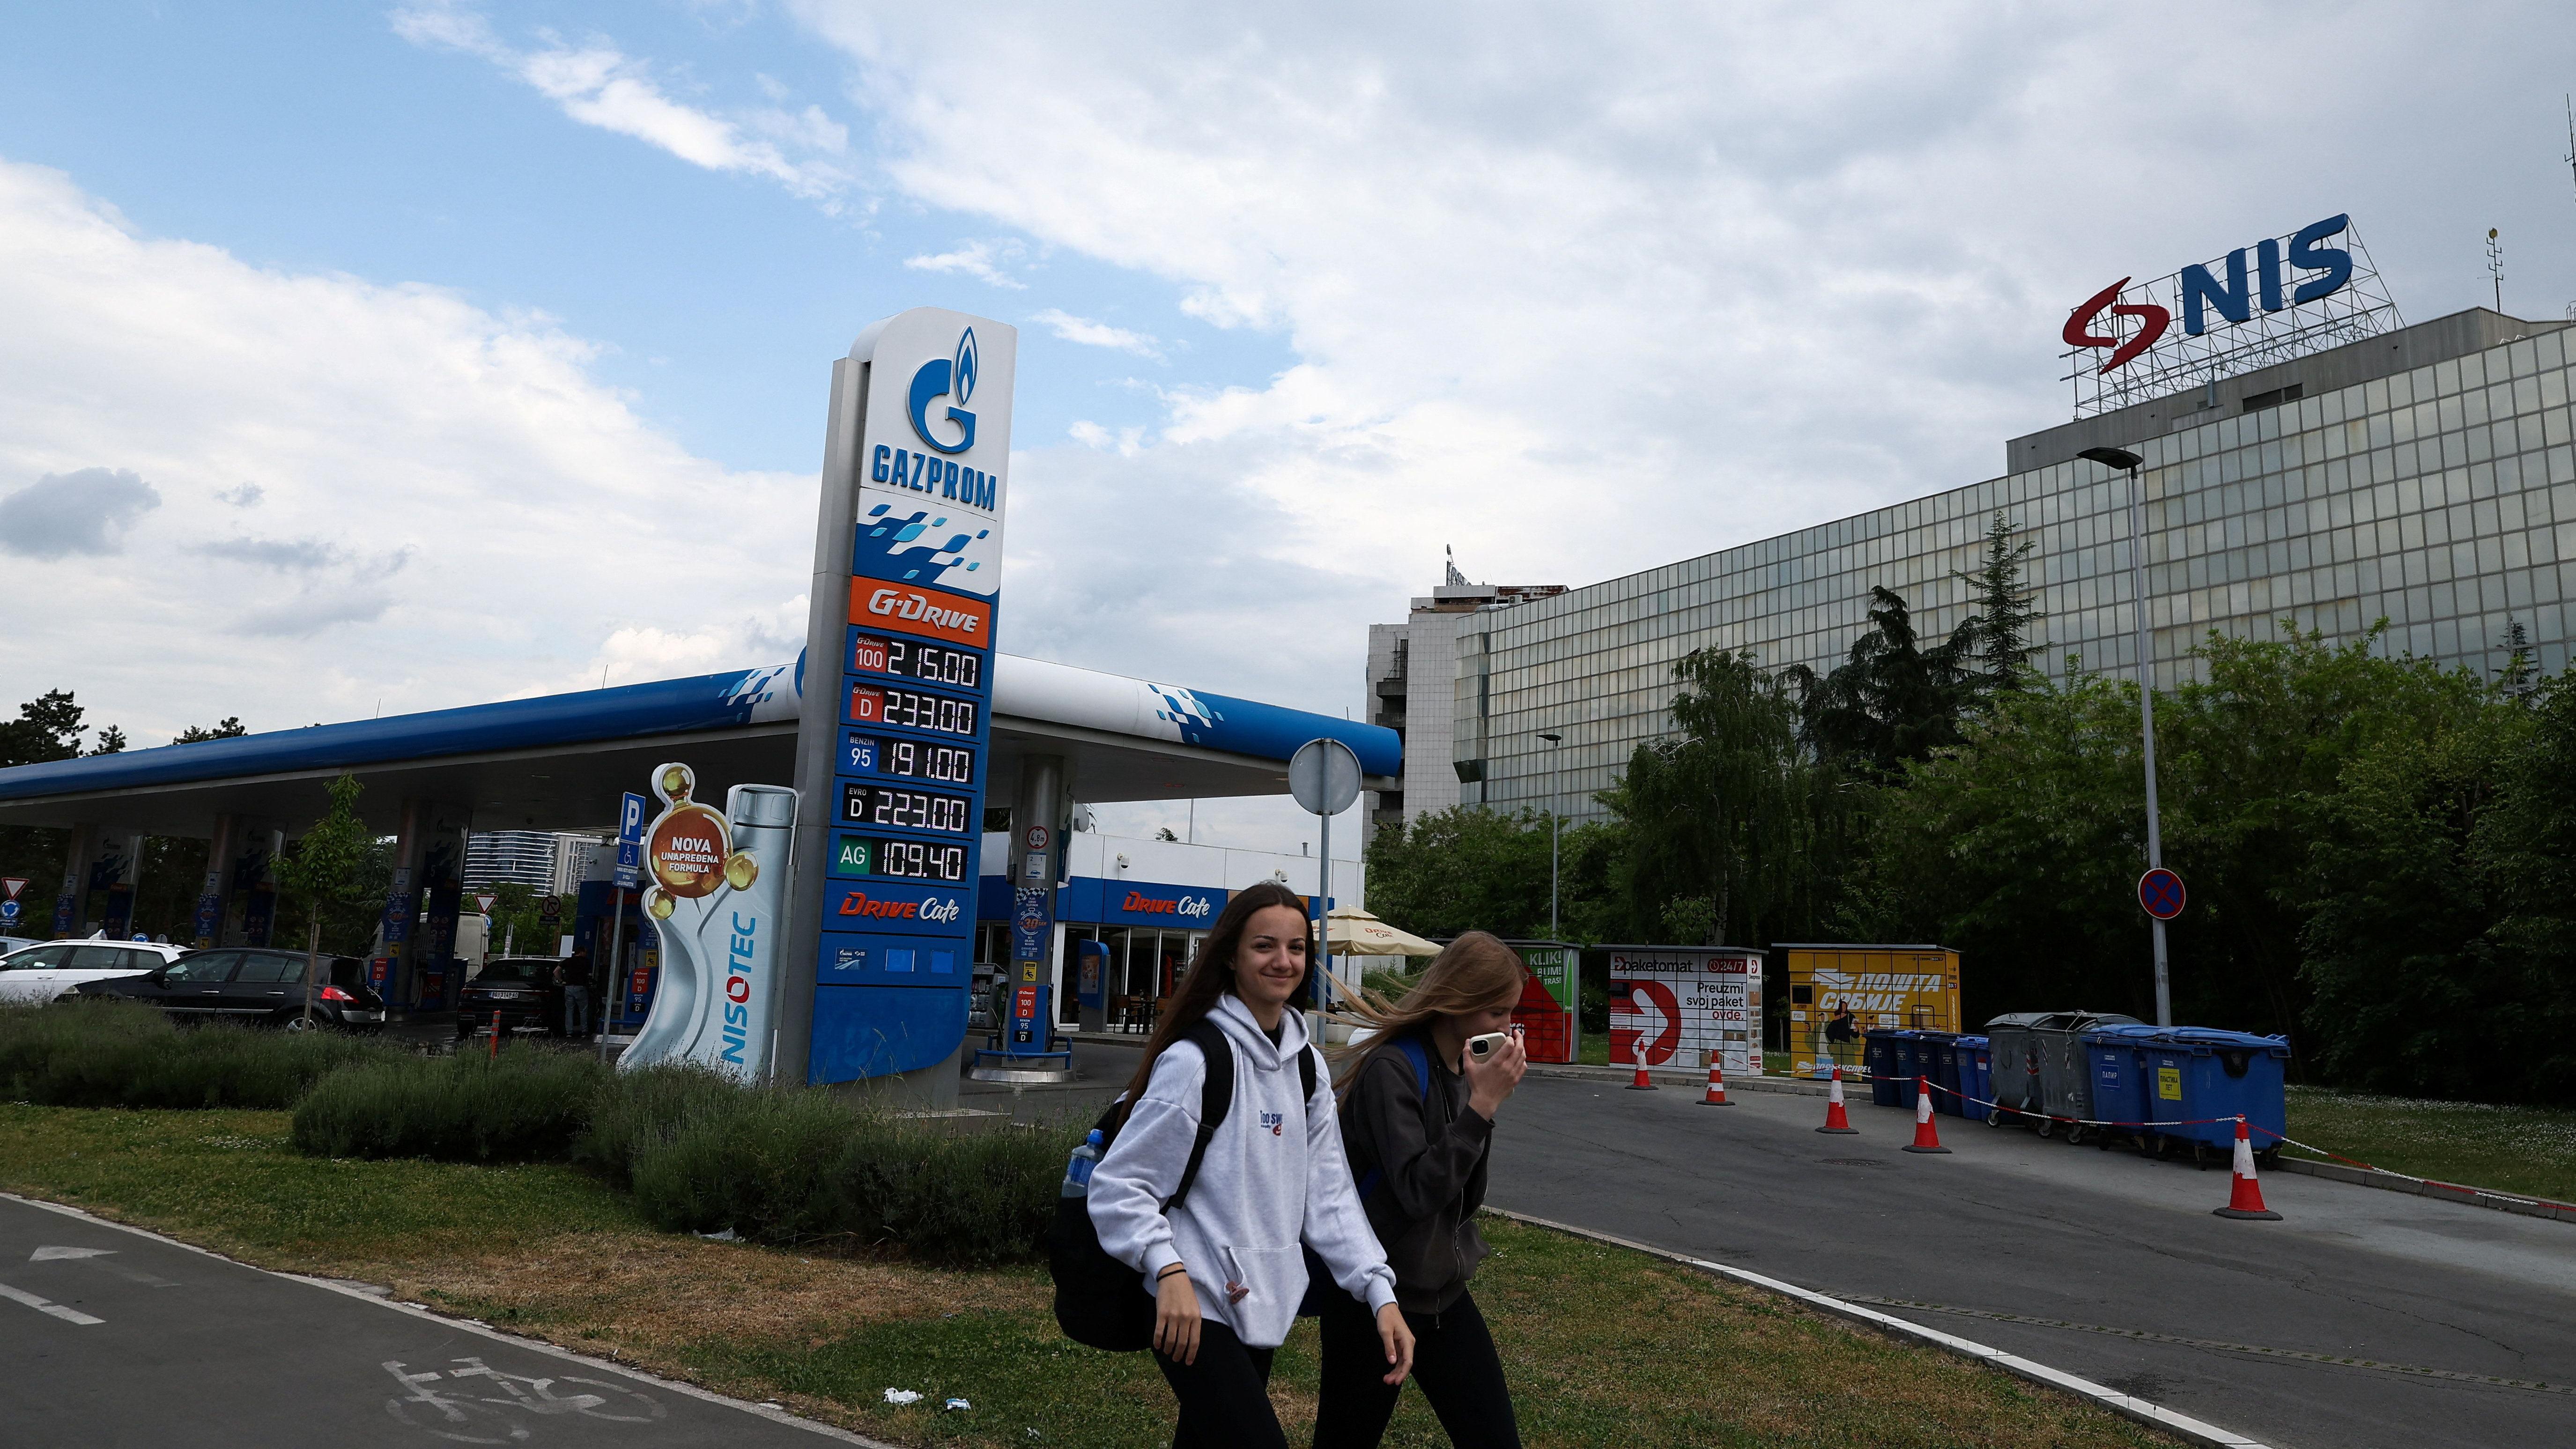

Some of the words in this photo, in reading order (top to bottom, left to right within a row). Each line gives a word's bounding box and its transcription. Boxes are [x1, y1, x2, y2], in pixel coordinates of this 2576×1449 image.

[2181, 213, 2353, 335] NIS
[871, 444, 996, 511] GAZPROM
[857, 648, 883, 668] 100
[860, 698, 872, 717] D
[883, 691, 973, 734] 233.00
[850, 737, 875, 747] BENZIN
[851, 748, 871, 767] 95
[891, 743, 970, 782] 191.00
[849, 788, 866, 796] EVRO
[625, 799, 640, 835] P
[851, 799, 862, 817] D
[875, 791, 965, 832] 223.00
[672, 836, 711, 853] NOVA
[1030, 833, 1044, 842] 4.8m
[661, 852, 719, 864] UNAPREĐENA
[840, 846, 866, 865] AG
[883, 843, 962, 880] 109.40
[669, 863, 710, 873] FORMULA
[838, 891, 918, 920] DRIVE
[919, 897, 960, 924] Cafe
[1123, 891, 1176, 916] DRIVE
[1177, 895, 1210, 917] Cafe
[1023, 917, 1038, 929] 30
[1530, 951, 1561, 965] KLIK!
[1720, 961, 1744, 971] 24/7
[1537, 966, 1561, 977] BUM!
[1624, 959, 1693, 975] paketomat
[721, 911, 756, 1065] NISOTEC
[1697, 983, 1743, 994] Preuzmi
[1856, 973, 1941, 992] ПОШТА
[1687, 995, 1709, 1009] svoj
[1711, 996, 1744, 1009] paket
[1819, 992, 1906, 1012] СРБИЈЕ
[1712, 1009, 1744, 1020] ovde.
[2102, 1071, 2117, 1079] ПАПИР
